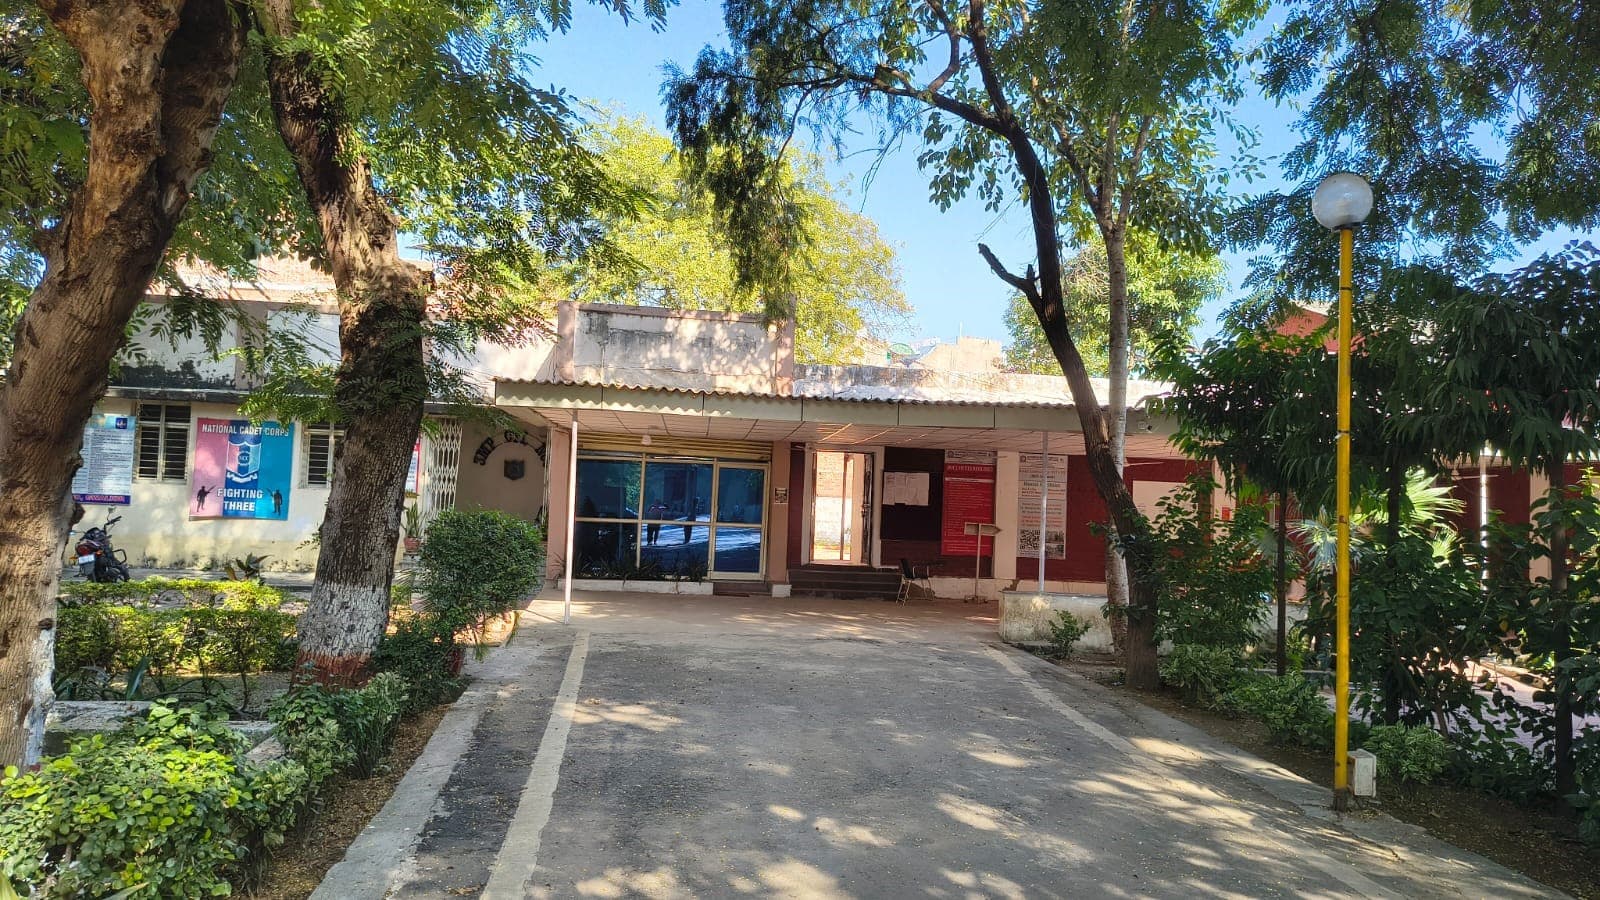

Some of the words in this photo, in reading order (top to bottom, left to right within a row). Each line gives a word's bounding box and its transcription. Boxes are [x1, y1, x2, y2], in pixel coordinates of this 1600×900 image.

[202, 423, 237, 434] NATIONAL
[240, 425, 262, 436] CADET
[264, 427, 289, 437] CORPS
[217, 488, 263, 499] FIGHTING
[224, 501, 255, 511] THREE
